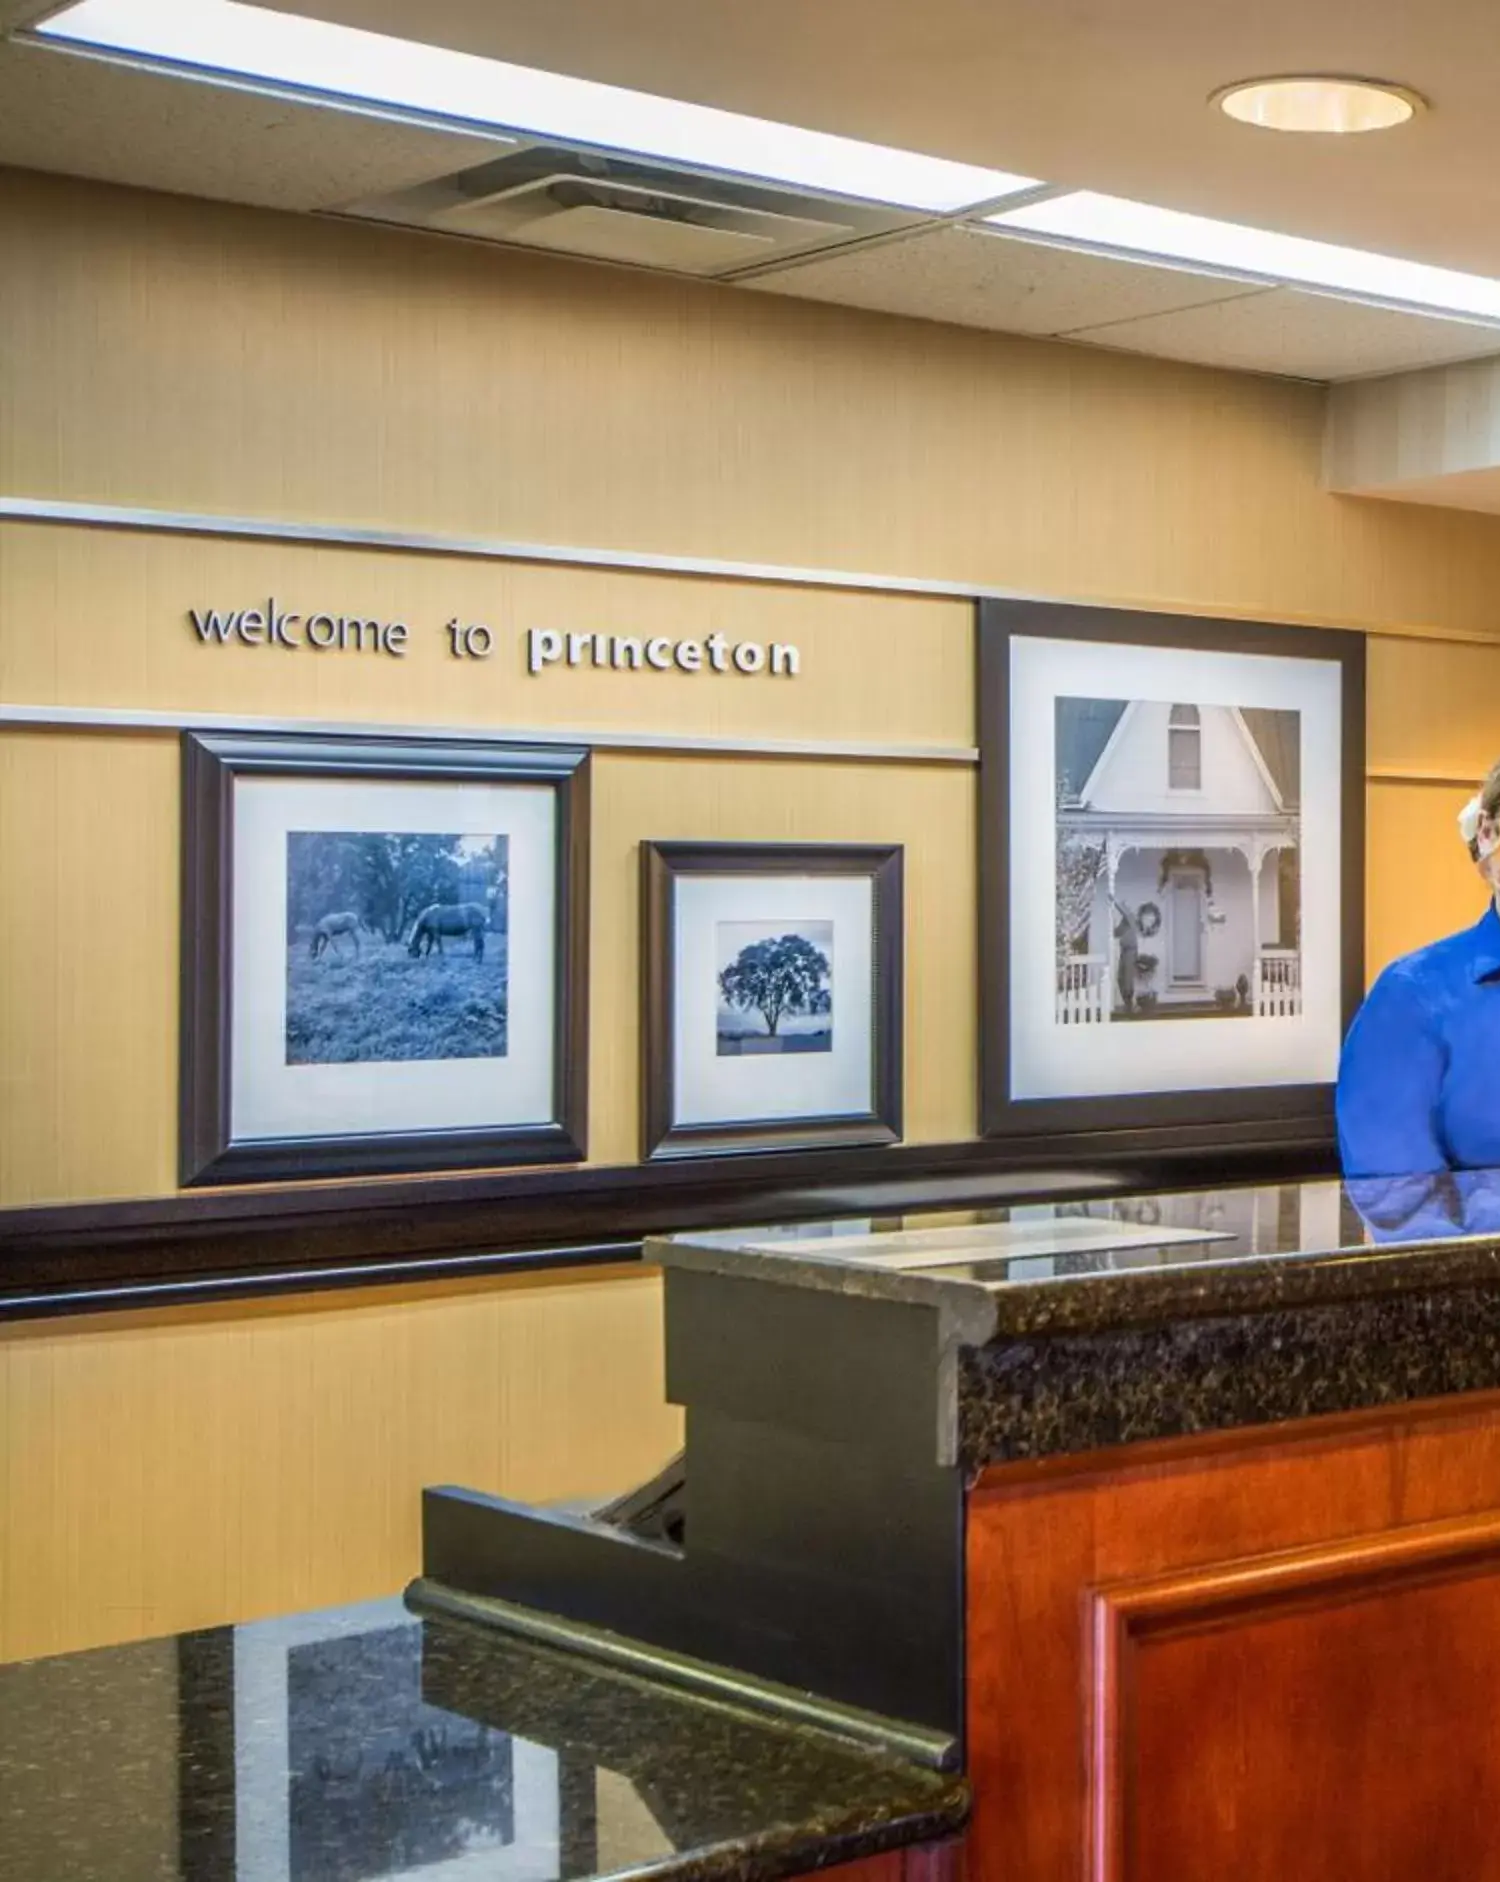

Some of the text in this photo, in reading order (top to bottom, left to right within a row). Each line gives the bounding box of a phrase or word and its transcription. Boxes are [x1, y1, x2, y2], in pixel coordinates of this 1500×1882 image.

[188, 597, 801, 678] welcome to princeton
